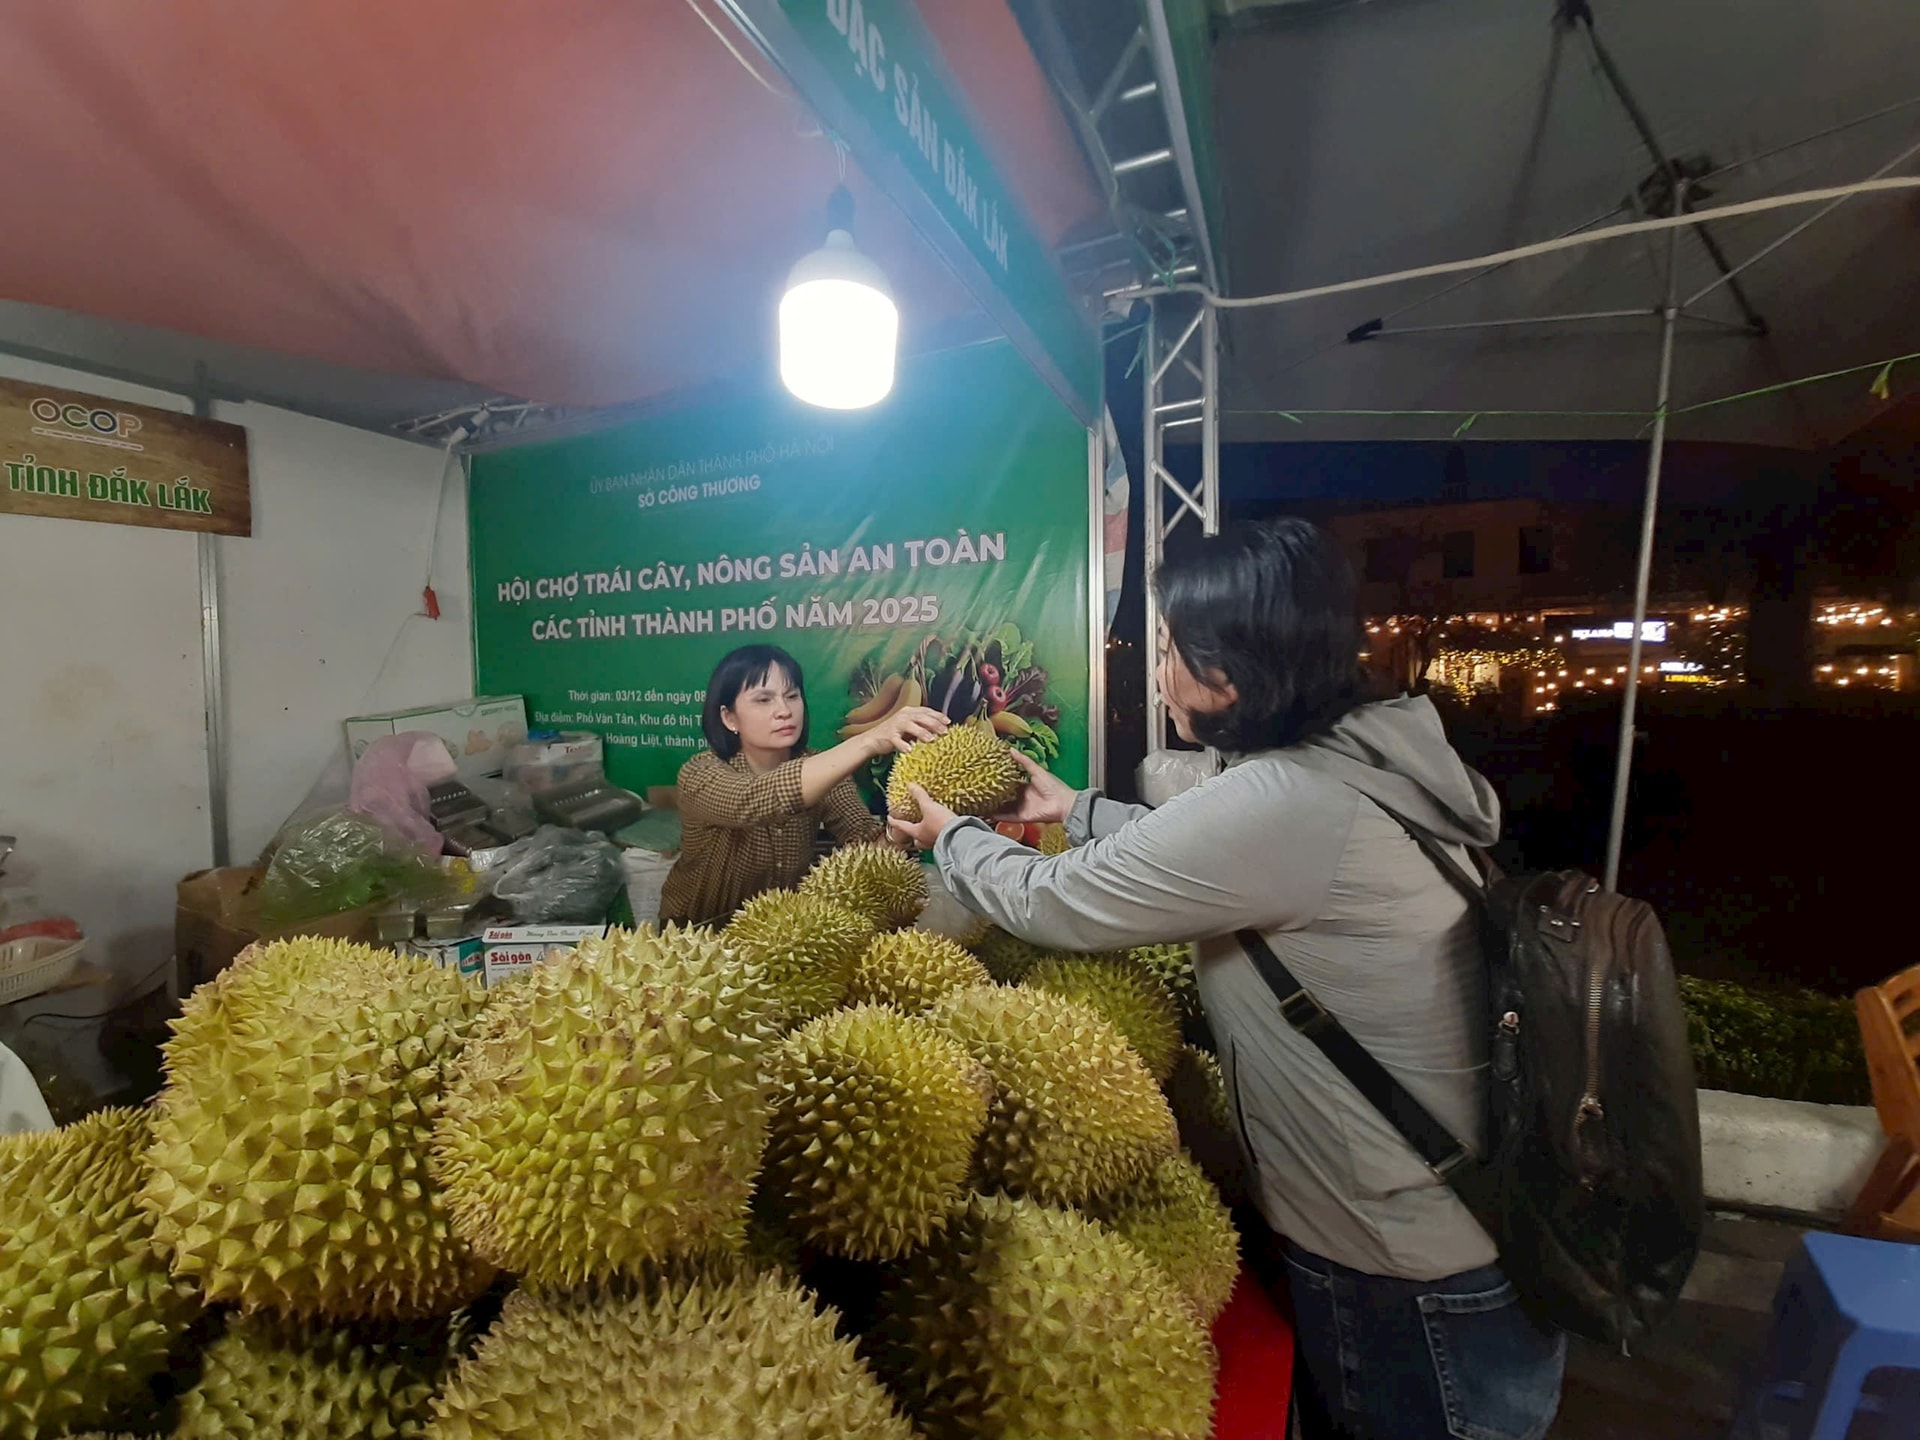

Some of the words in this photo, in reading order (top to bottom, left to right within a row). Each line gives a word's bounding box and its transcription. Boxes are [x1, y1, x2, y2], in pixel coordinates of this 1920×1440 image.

[894, 63, 938, 173] SẢN
[31, 398, 142, 437] OCOP
[5, 454, 79, 497] TỈNH
[87, 467, 151, 506] ĐẮK
[157, 476, 212, 514] LẮK
[606, 473, 629, 493] BAN
[667, 460, 696, 482] DÂN
[698, 453, 742, 474] THÀNH
[638, 489, 656, 508] SỞ
[658, 484, 698, 505] CÔNG
[702, 474, 761, 498] THƯƠNG
[497, 576, 530, 606] HỘI
[535, 571, 579, 602] CHỢ
[584, 565, 631, 594] TRÁI
[637, 561, 691, 591] CÂY,
[698, 554, 771, 586] NÔNG
[779, 542, 838, 578] SẢN
[848, 543, 894, 573] AN
[904, 528, 1005, 567] TOÀN
[532, 614, 572, 640] CÁC
[577, 608, 625, 637] TỈNH
[632, 606, 713, 635] THÀNH
[721, 596, 777, 632] PHỐ
[785, 596, 852, 628] NĂM
[862, 595, 939, 625] 2025
[615, 690, 642, 702] 03/12
[644, 687, 664, 702] đến
[666, 690, 692, 705] ngày
[606, 732, 638, 748] Hoàng
[665, 735, 695, 747] thành
[640, 713, 660, 726] Khu
[663, 713, 677, 726] đô
[679, 714, 693, 729] thị
